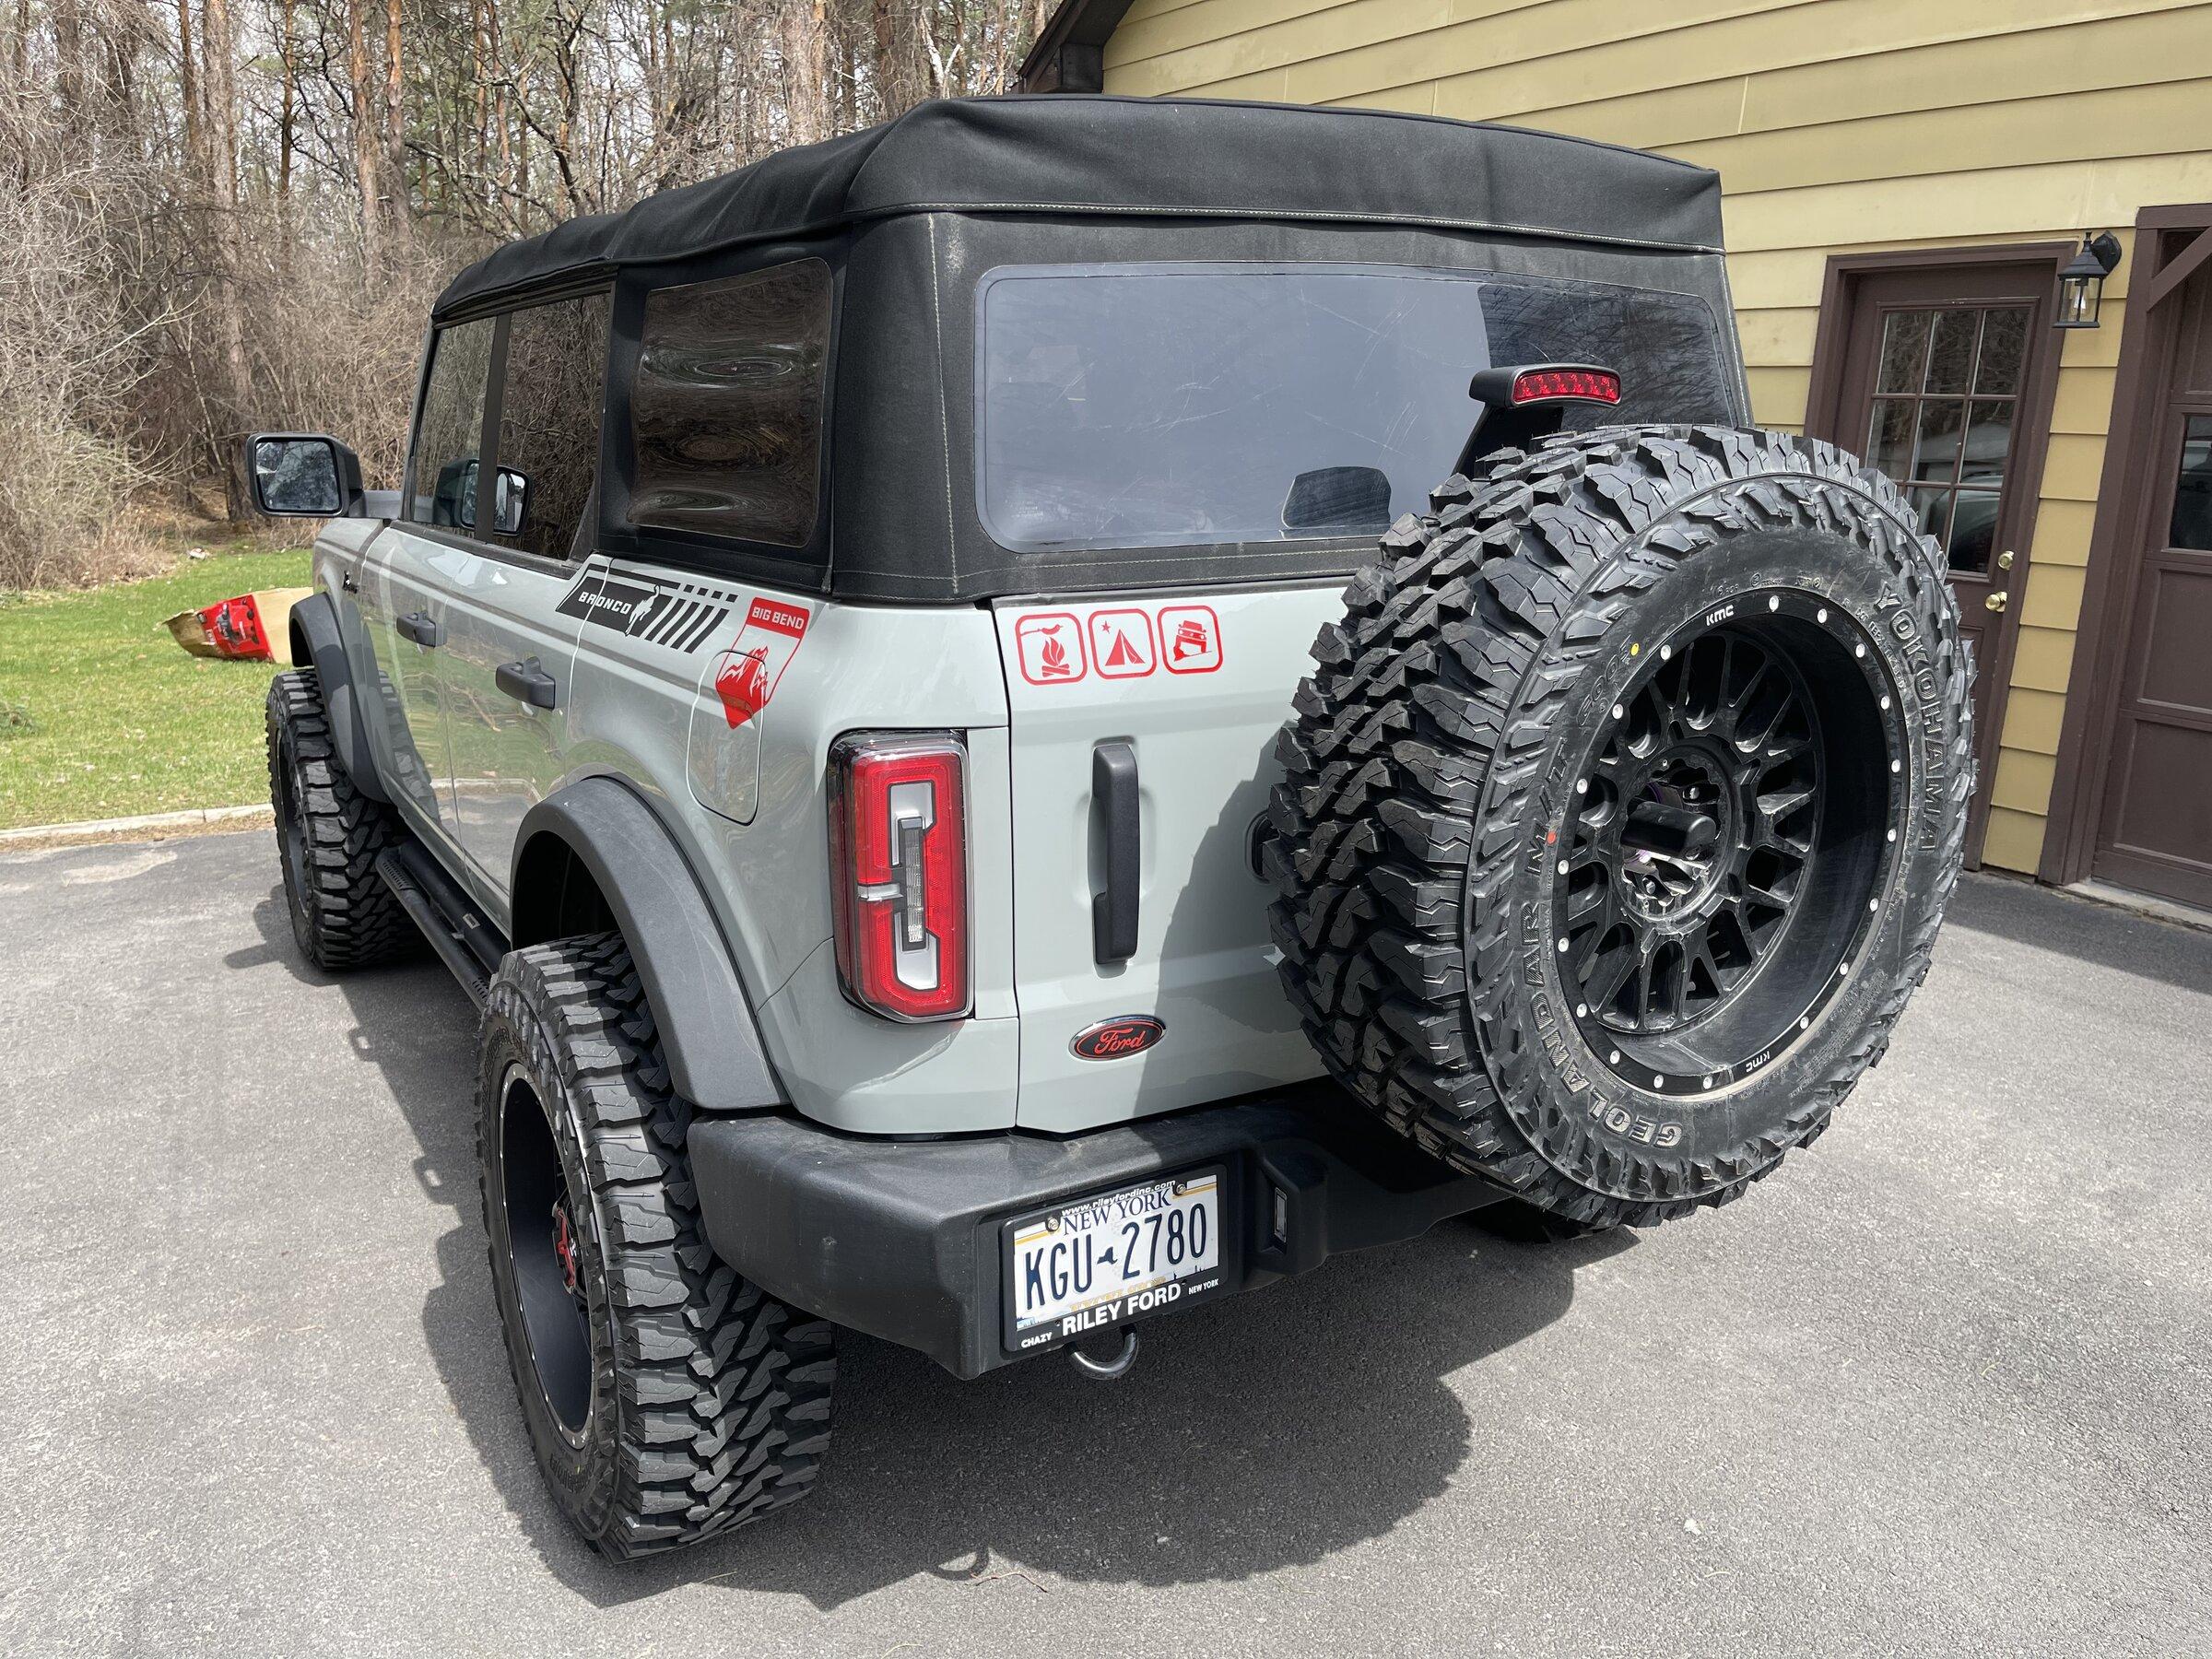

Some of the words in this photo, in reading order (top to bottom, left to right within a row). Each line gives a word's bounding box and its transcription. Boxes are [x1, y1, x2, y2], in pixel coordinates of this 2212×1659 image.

[578, 591, 632, 615] BRONCO
[752, 606, 772, 621] BIG
[772, 610, 805, 629] BEND
[1874, 580, 1945, 852] YOKOHAMA
[1094, 1028, 1147, 1054] Ford
[1522, 902, 1683, 1147] GEOLANDAR
[1061, 1180, 1176, 1216] www.rileyfordinc.com
[1064, 1205, 1112, 1236] NEW
[1116, 1189, 1171, 1219] YORK
[1188, 1283, 1203, 1295] NEW
[1203, 1278, 1219, 1291] YORK
[1020, 1332, 1053, 1348] CHAZY
[1062, 1300, 1122, 1337] RILEY
[1127, 1283, 1182, 1315] FORD
